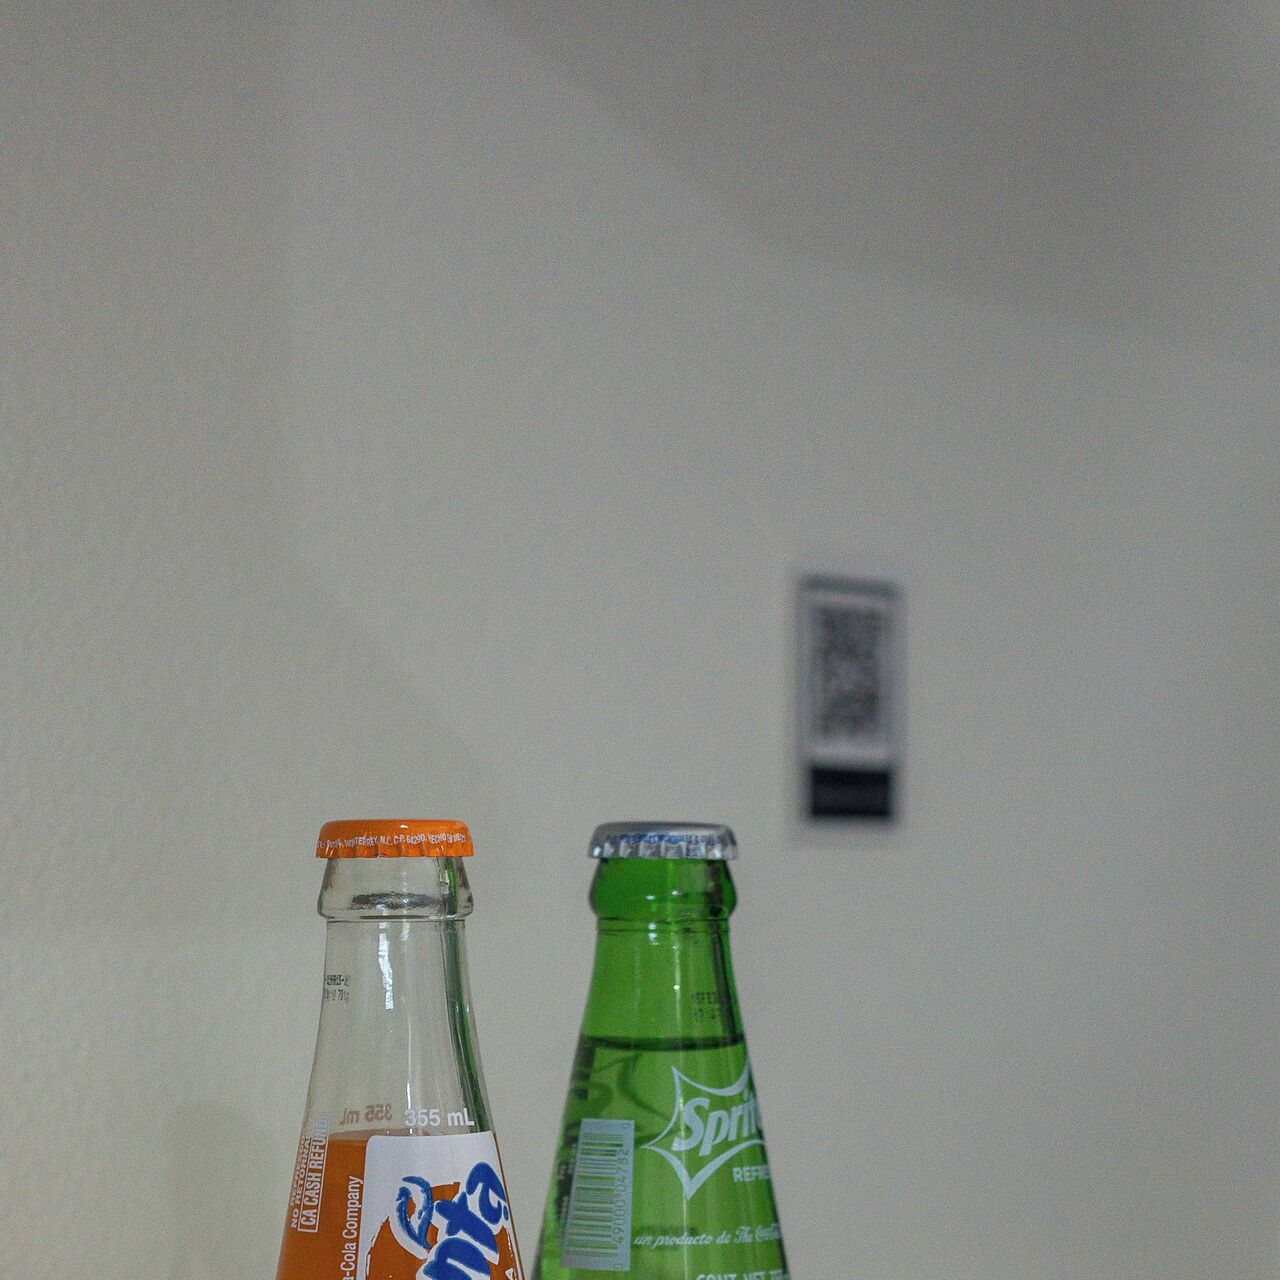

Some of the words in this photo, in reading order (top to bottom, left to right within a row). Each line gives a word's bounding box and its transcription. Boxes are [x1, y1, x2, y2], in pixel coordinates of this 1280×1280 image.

[404, 1108, 441, 1127] 355
[447, 1107, 475, 1127] mL
[671, 1088, 761, 1156] Sprit
[308, 1118, 328, 1168] REFUND
[295, 1137, 311, 1205] RETORNA
[304, 1173, 322, 1206] CASH
[291, 1208, 300, 1229] NO
[300, 1208, 317, 1226] CA
[342, 1175, 363, 1238] Company
[634, 1235, 653, 1246] un
[652, 1231, 714, 1250] producto
[716, 1230, 731, 1245] de
